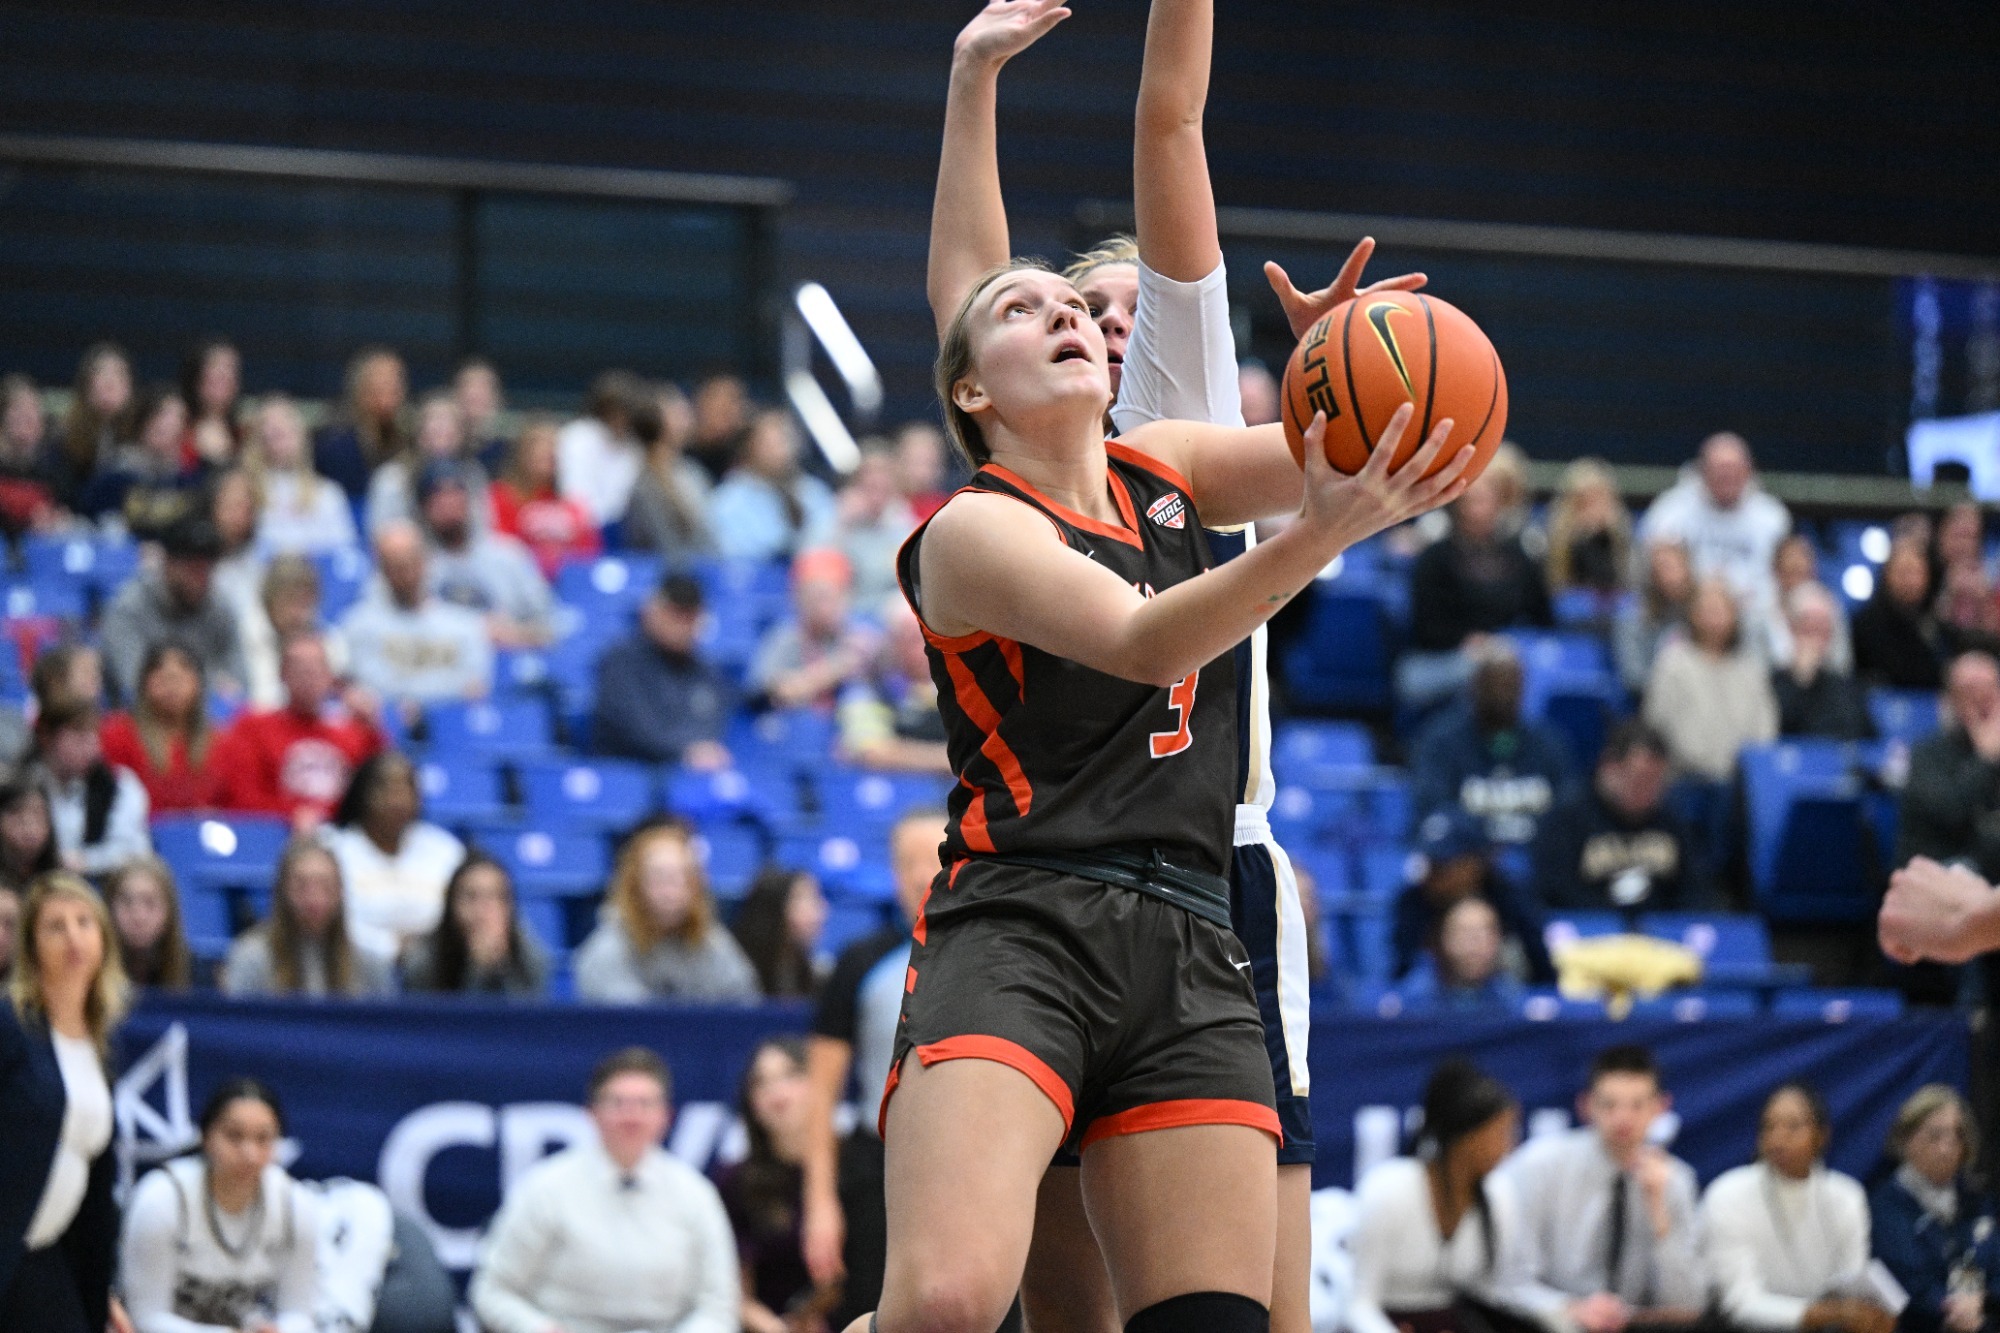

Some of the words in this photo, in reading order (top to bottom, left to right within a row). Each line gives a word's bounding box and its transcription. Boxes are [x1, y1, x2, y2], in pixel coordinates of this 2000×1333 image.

[1303, 315, 1341, 423] ELITE
[1152, 498, 1185, 526] MAC
[1149, 667, 1200, 759] 3
